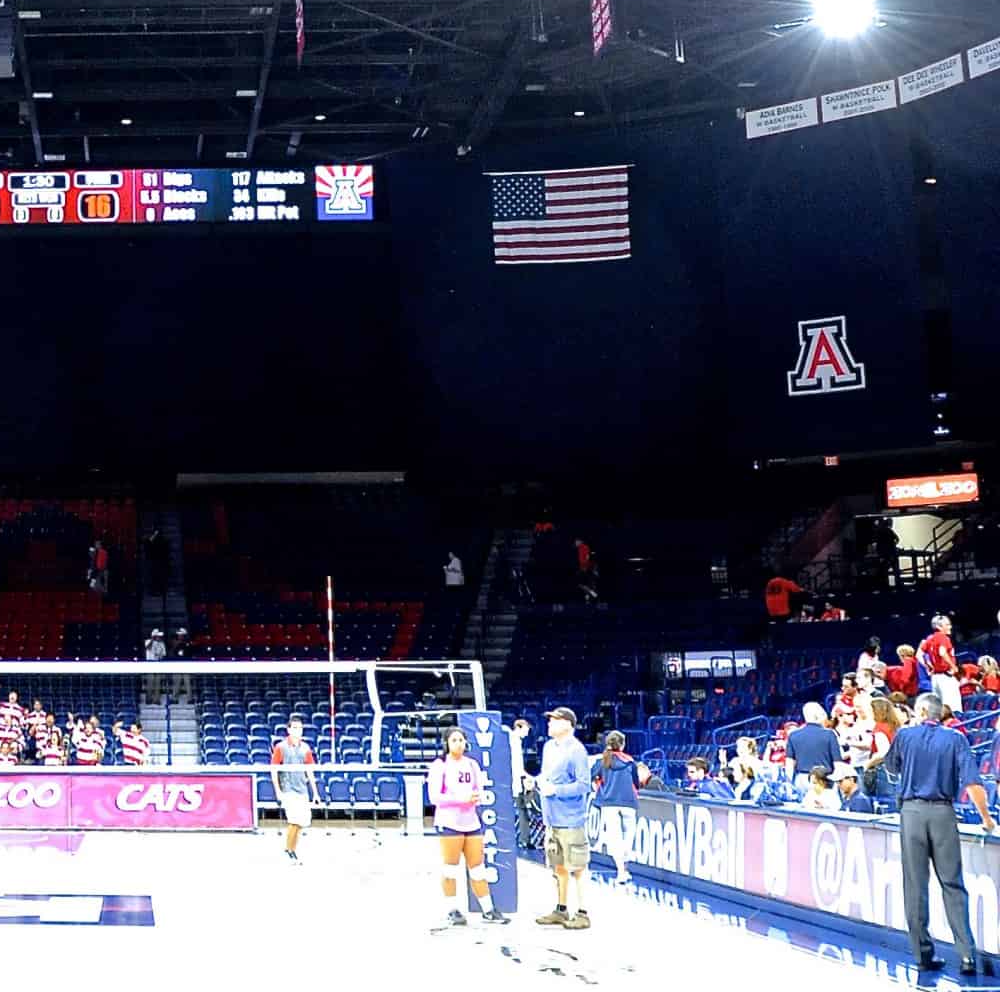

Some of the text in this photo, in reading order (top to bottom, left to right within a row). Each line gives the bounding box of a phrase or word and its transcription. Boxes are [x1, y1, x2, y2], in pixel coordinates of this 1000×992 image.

[85, 195, 112, 218] 16
[458, 771, 472, 784] 20
[114, 783, 205, 812] CATS
